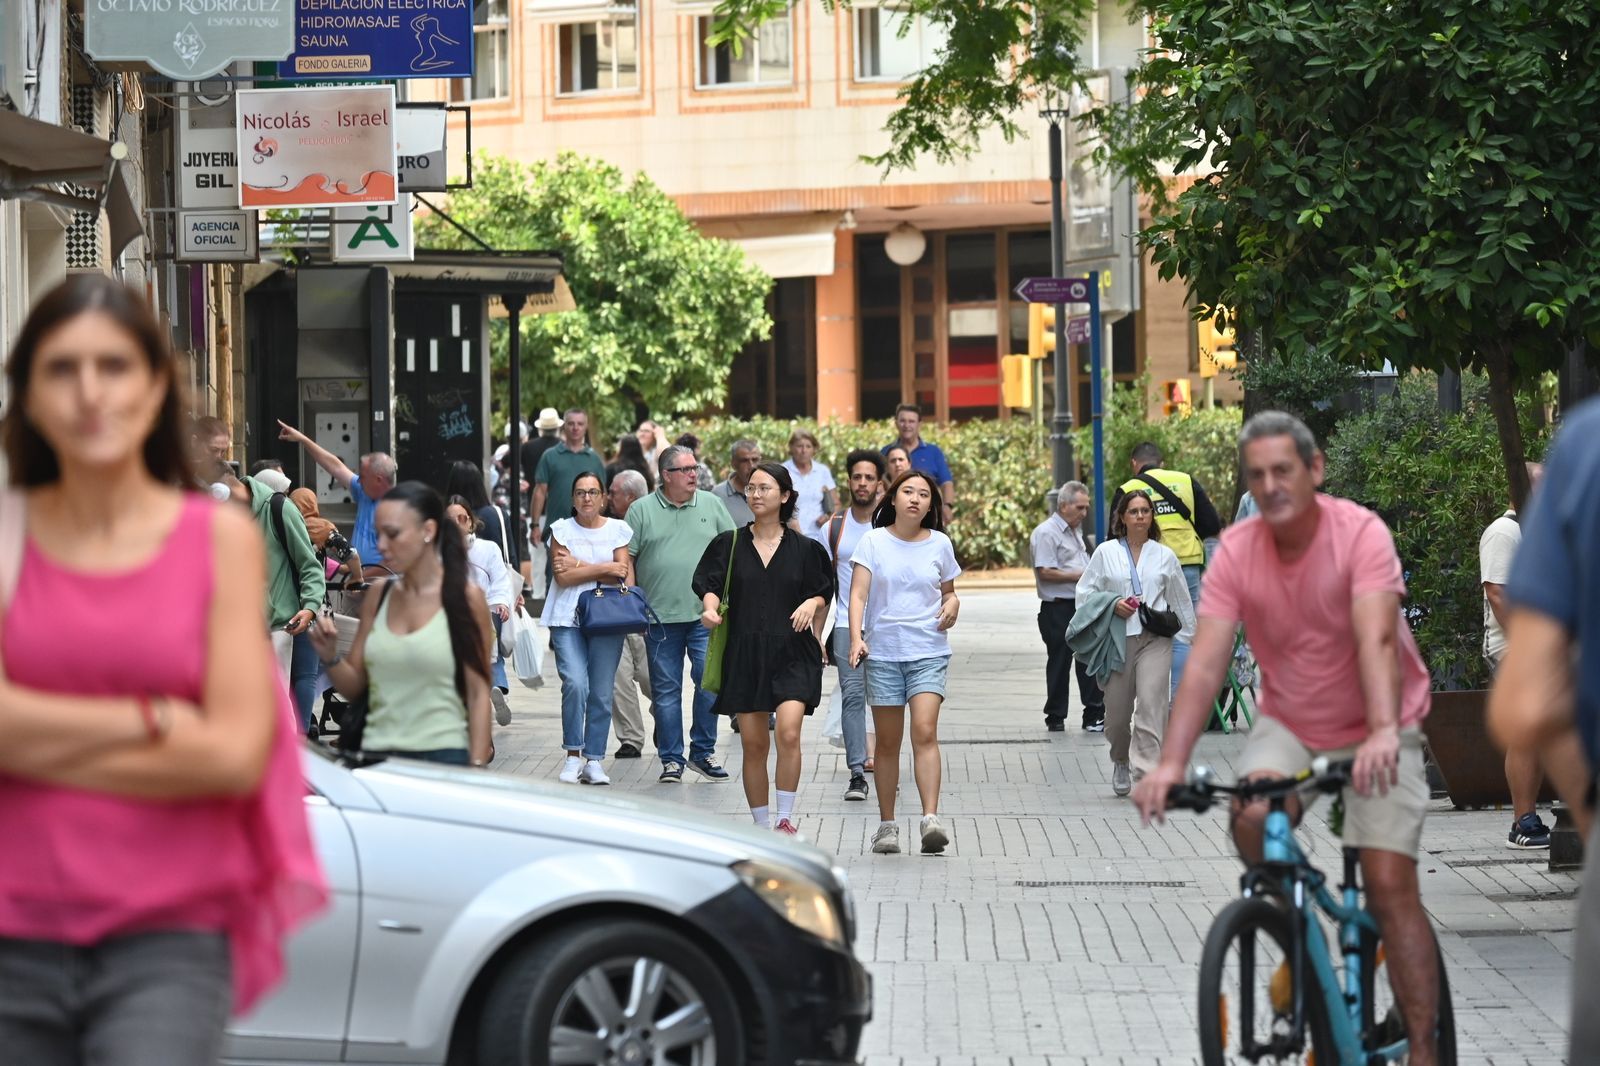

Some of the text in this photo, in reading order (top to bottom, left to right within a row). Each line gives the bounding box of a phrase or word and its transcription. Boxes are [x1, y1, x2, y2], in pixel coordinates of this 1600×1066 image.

[300, 16, 400, 29] HIDROMASAJE
[300, 35, 349, 47] SAUNA
[298, 58, 368, 70] FONDO GALERIA
[243, 110, 311, 130] Nicolás
[337, 108, 388, 128] Israel
[195, 174, 233, 188] GIL
[192, 222, 240, 231] AGENCIA
[194, 235, 236, 244] OFICIAL
